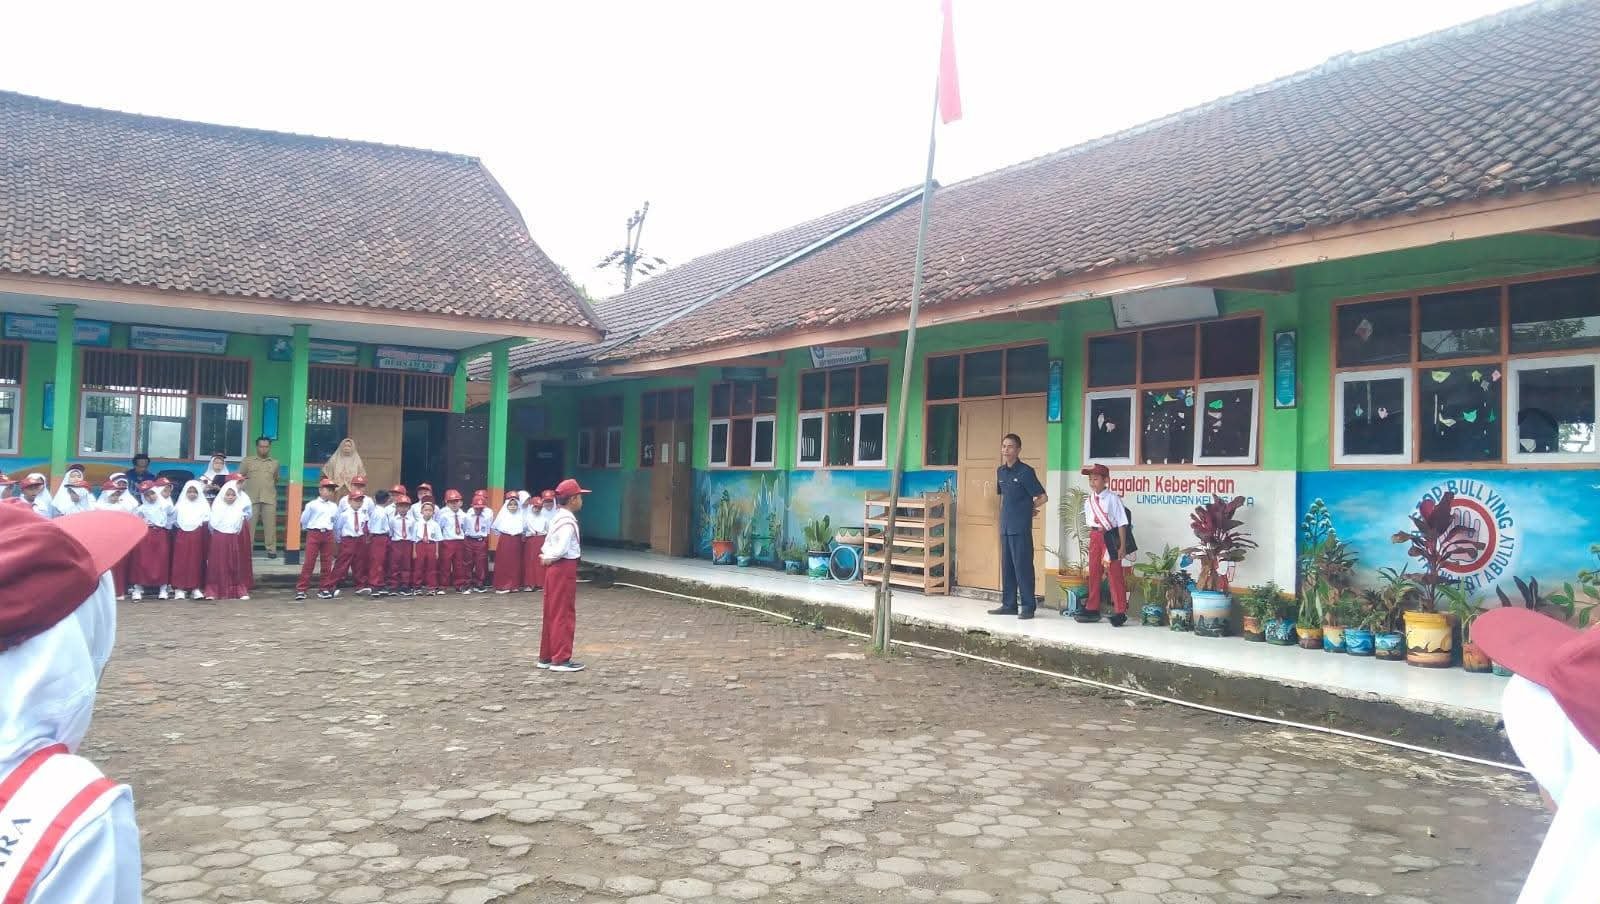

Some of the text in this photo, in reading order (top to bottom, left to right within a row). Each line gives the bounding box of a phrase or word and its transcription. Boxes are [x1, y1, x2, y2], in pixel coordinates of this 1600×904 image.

[1155, 475, 1235, 494] Kebersihan
[1136, 494, 1195, 505] LINGKUNGAN
[1196, 495, 1228, 506] KELS
[0, 818, 32, 867] RA
